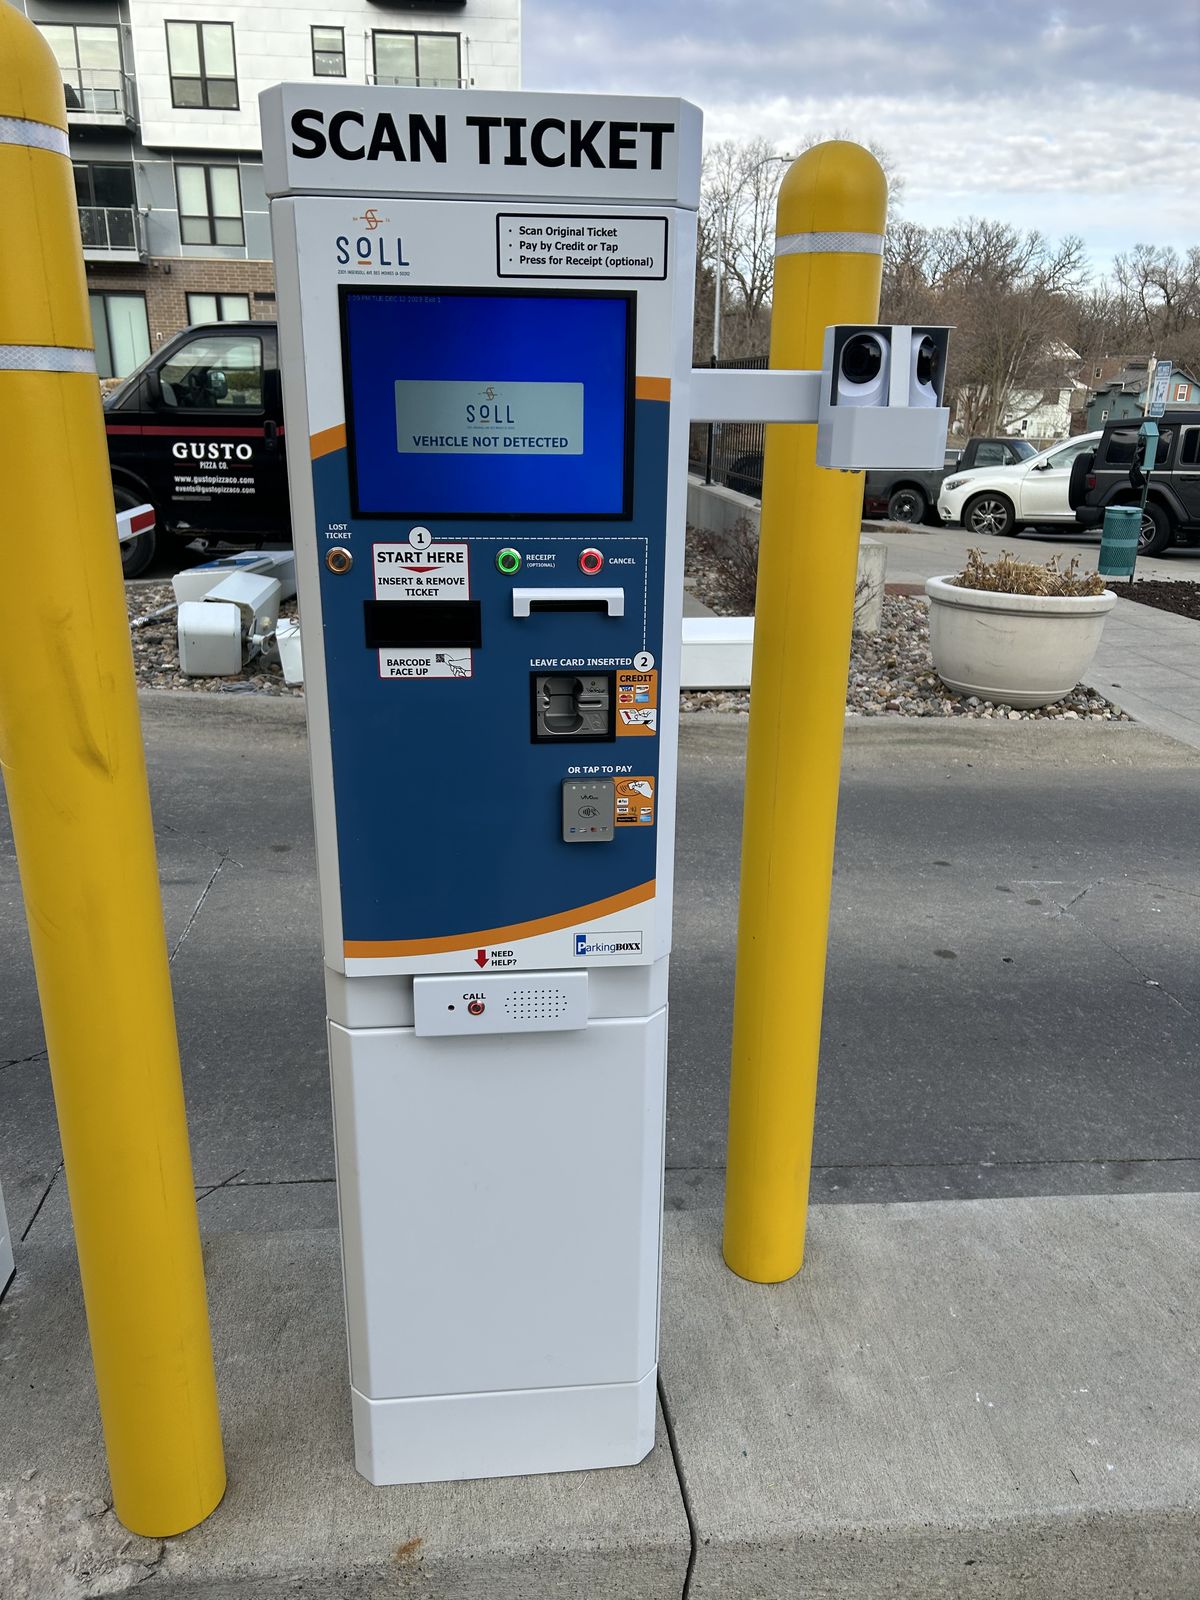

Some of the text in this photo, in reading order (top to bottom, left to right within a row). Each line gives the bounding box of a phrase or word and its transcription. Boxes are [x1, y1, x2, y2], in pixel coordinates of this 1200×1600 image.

[291, 109, 675, 170] SCAN TICKET
[519, 226, 618, 238] Scan Original Ticket
[336, 236, 410, 266] SOLL
[519, 241, 619, 253] Pay by Credit or Tap
[519, 255, 654, 269] Press for Receipt (optional)
[466, 405, 515, 423] SOLL
[413, 435, 569, 448] VEHICLE NOT DETECTED
[172, 442, 252, 460] GUSTO
[199, 461, 229, 470] PIZZA CO.
[174, 475, 255, 485] www.gustopizzaco.com
[175, 485, 256, 494] events@gustopizzaco.com
[416, 533, 425, 544] 1
[377, 552, 464, 563] START HERE
[608, 557, 636, 565] CANCEL
[378, 577, 465, 586] INSERT & REMOVE
[405, 588, 439, 597] TICKET
[387, 658, 431, 667] BARCODE
[530, 657, 632, 667] LEAVE CARD INSERTED
[640, 657, 648, 667] 2
[390, 668, 413, 676] FACE
[619, 674, 653, 682] CREDIT
[568, 766, 581, 774] OR
[616, 765, 632, 773] PAY
